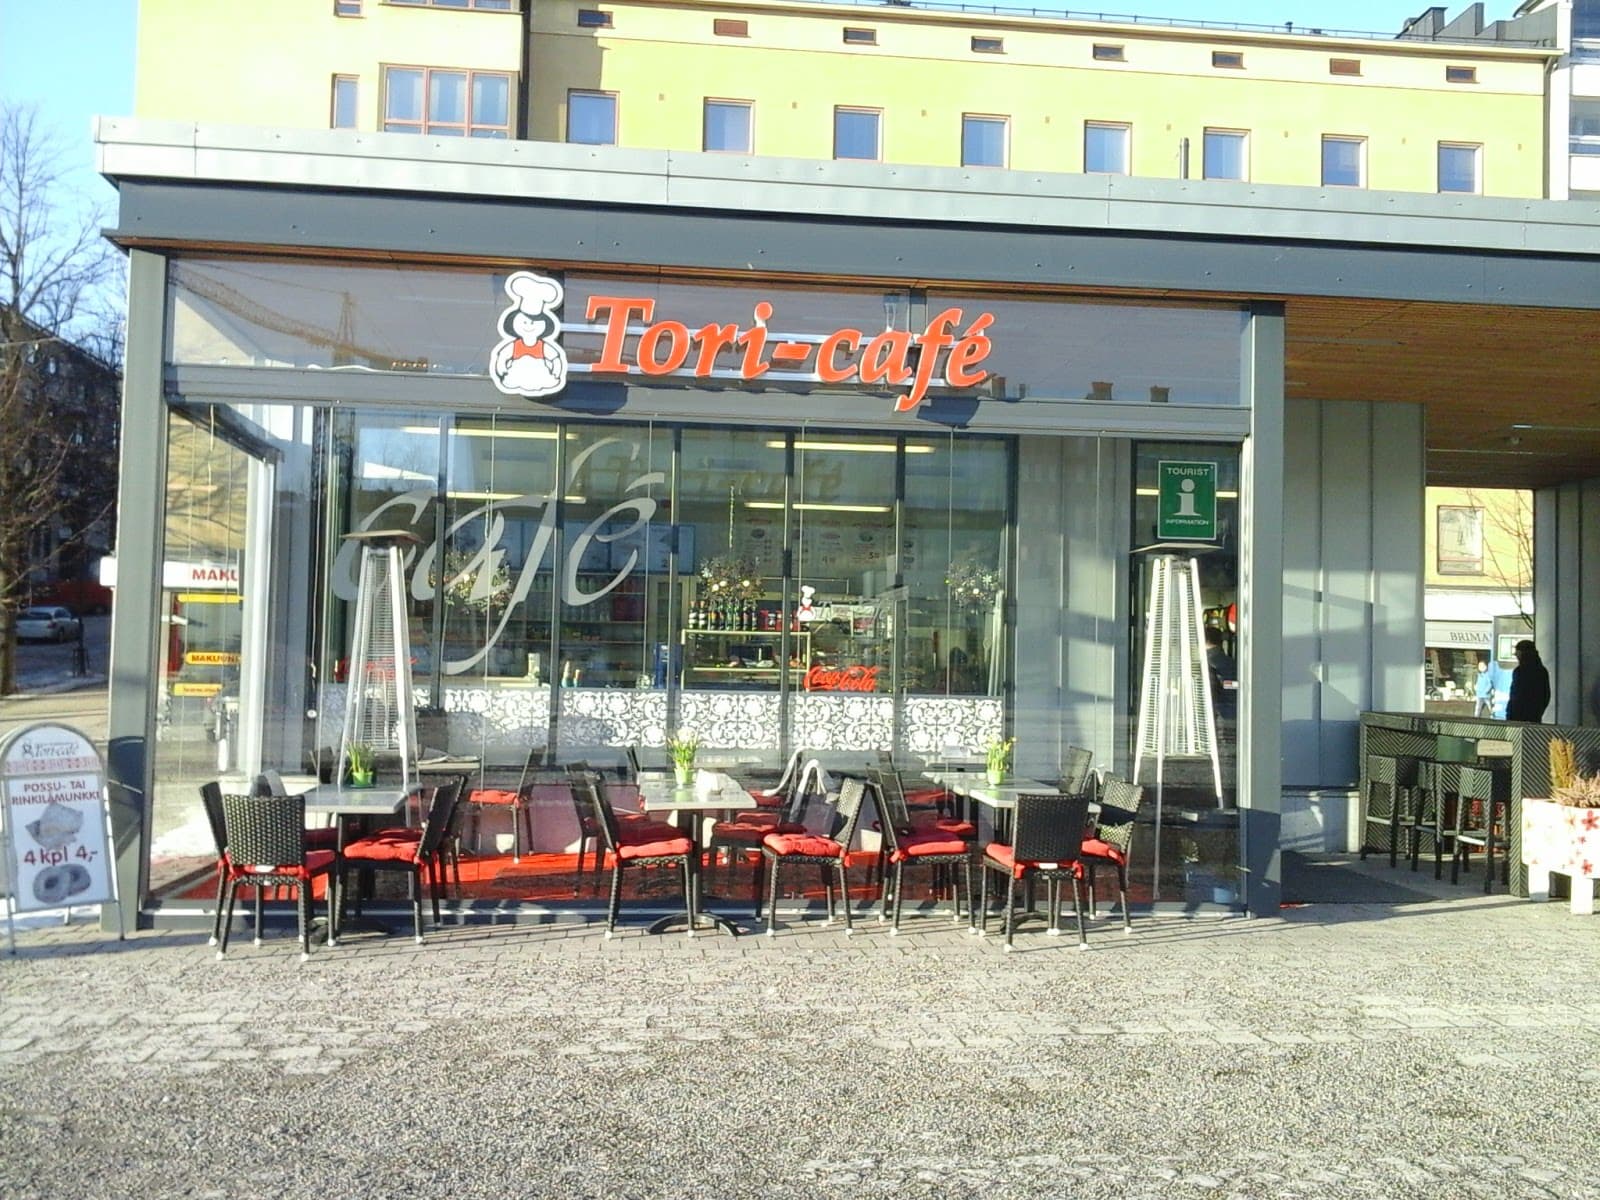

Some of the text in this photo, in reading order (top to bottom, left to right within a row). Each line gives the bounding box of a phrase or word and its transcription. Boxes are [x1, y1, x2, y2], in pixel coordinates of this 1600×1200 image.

[584, 295, 995, 411] Tori-café
[1166, 467, 1209, 476] TOURIST
[1449, 632, 1492, 643] BRIMA
[23, 779, 86, 792] POSSU- TAI
[24, 850, 37, 866] 4
[40, 845, 68, 867] kpl
